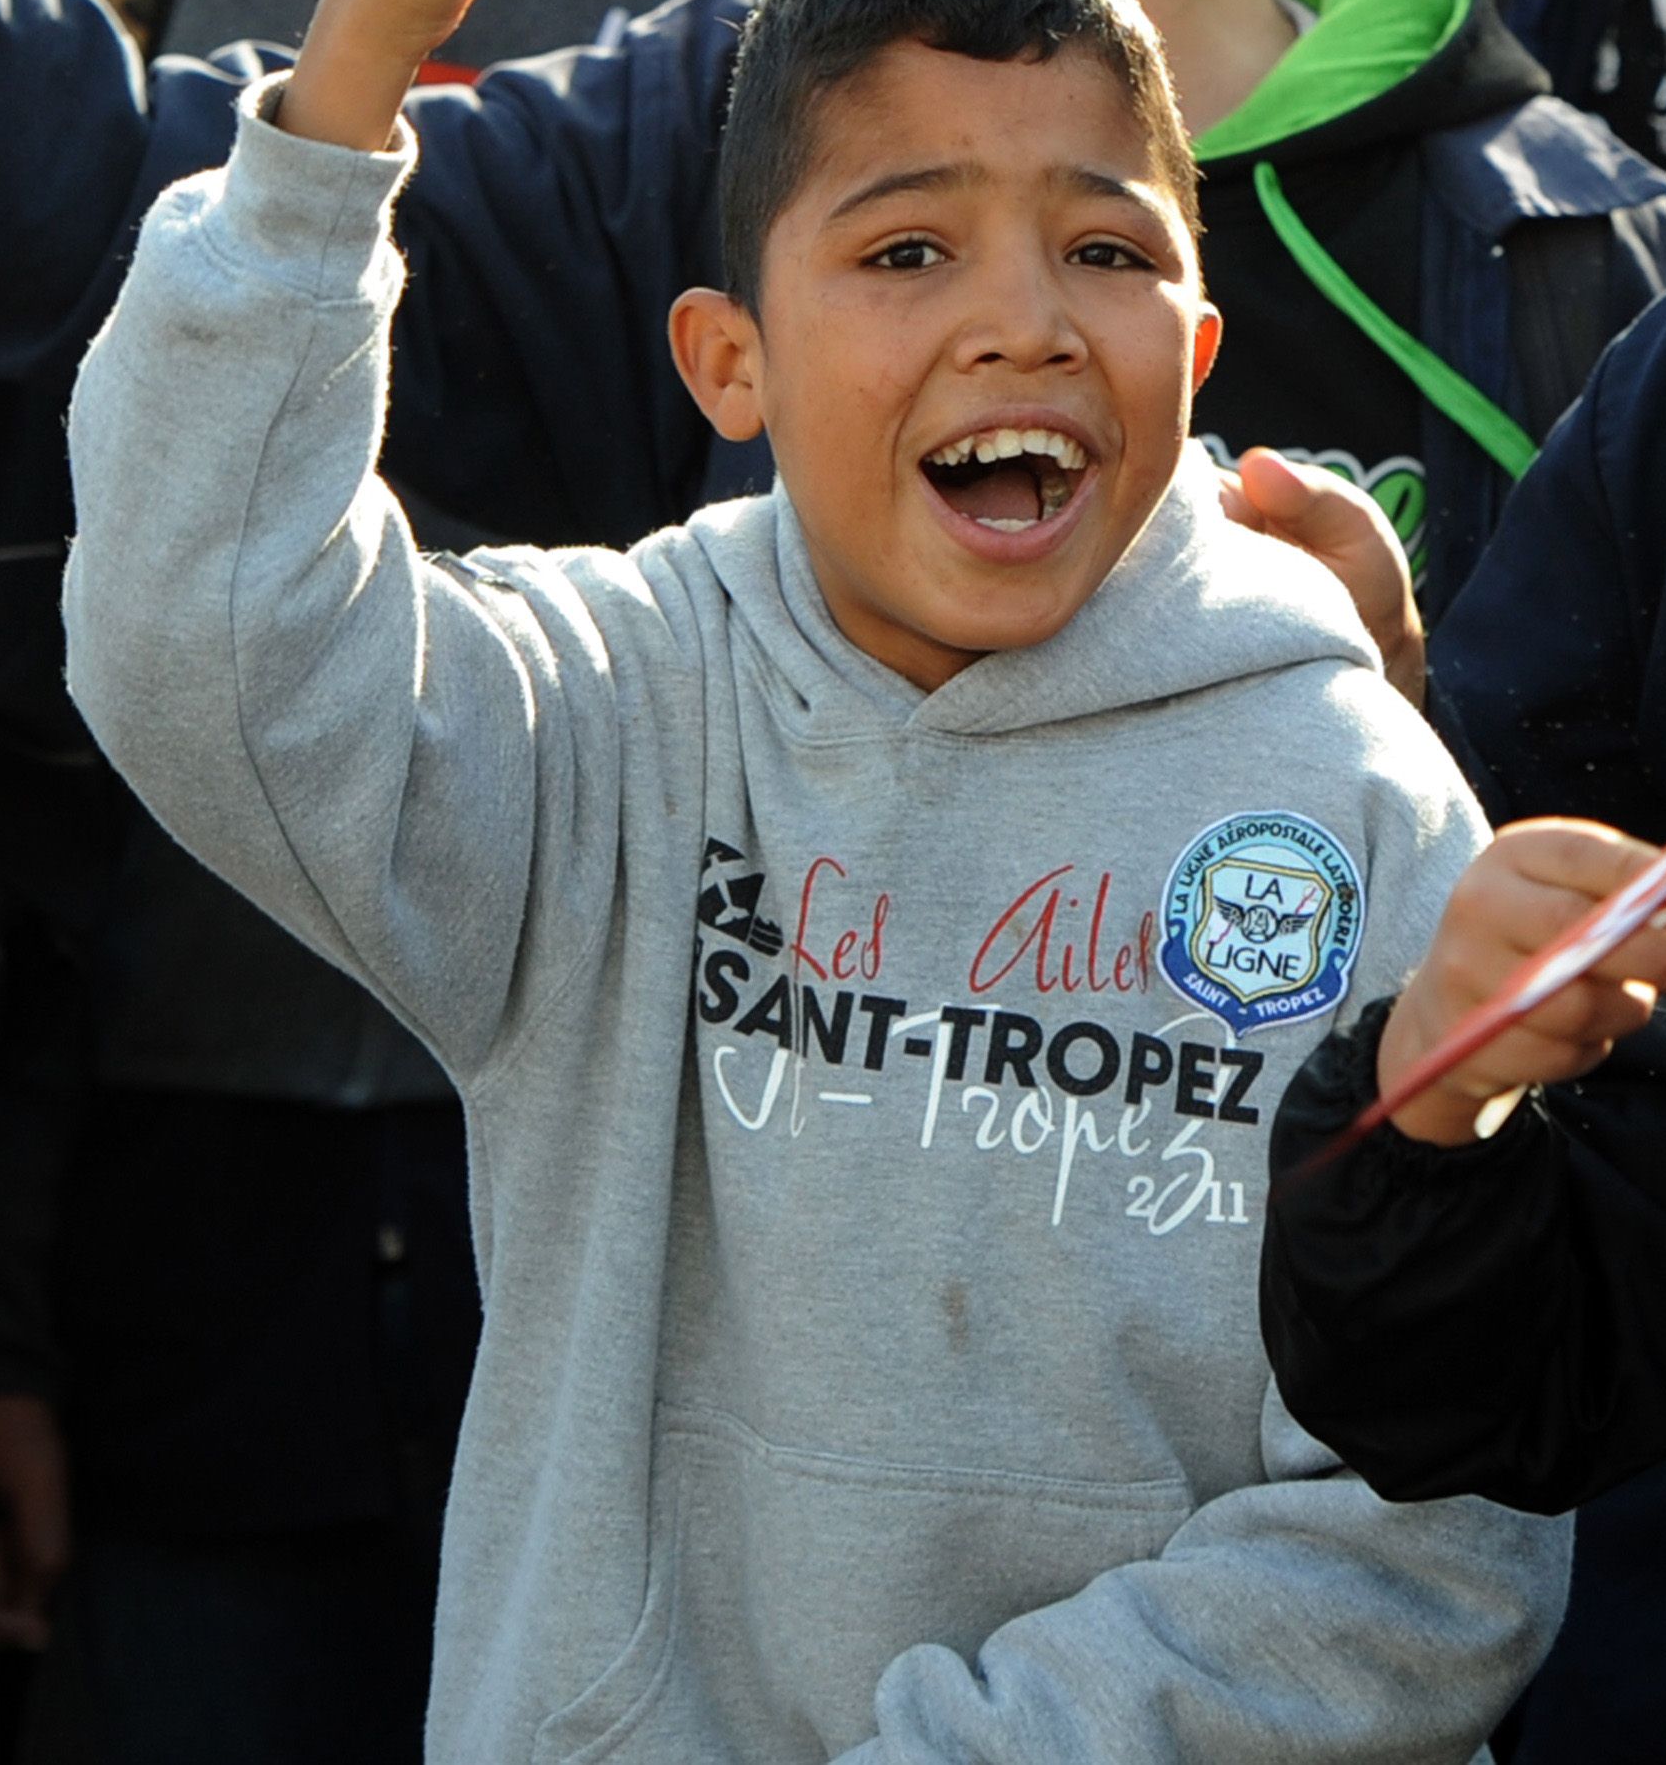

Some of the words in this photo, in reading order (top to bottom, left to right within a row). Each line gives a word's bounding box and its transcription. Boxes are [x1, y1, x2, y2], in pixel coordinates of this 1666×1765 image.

[1178, 841, 1216, 887] LIGNE
[1173, 893, 1190, 915] LA
[1245, 873, 1284, 905] LA
[1206, 940, 1302, 983] LIGNE
[1183, 973, 1230, 1009] SAINT
[1254, 986, 1326, 1019] TROPEZ
